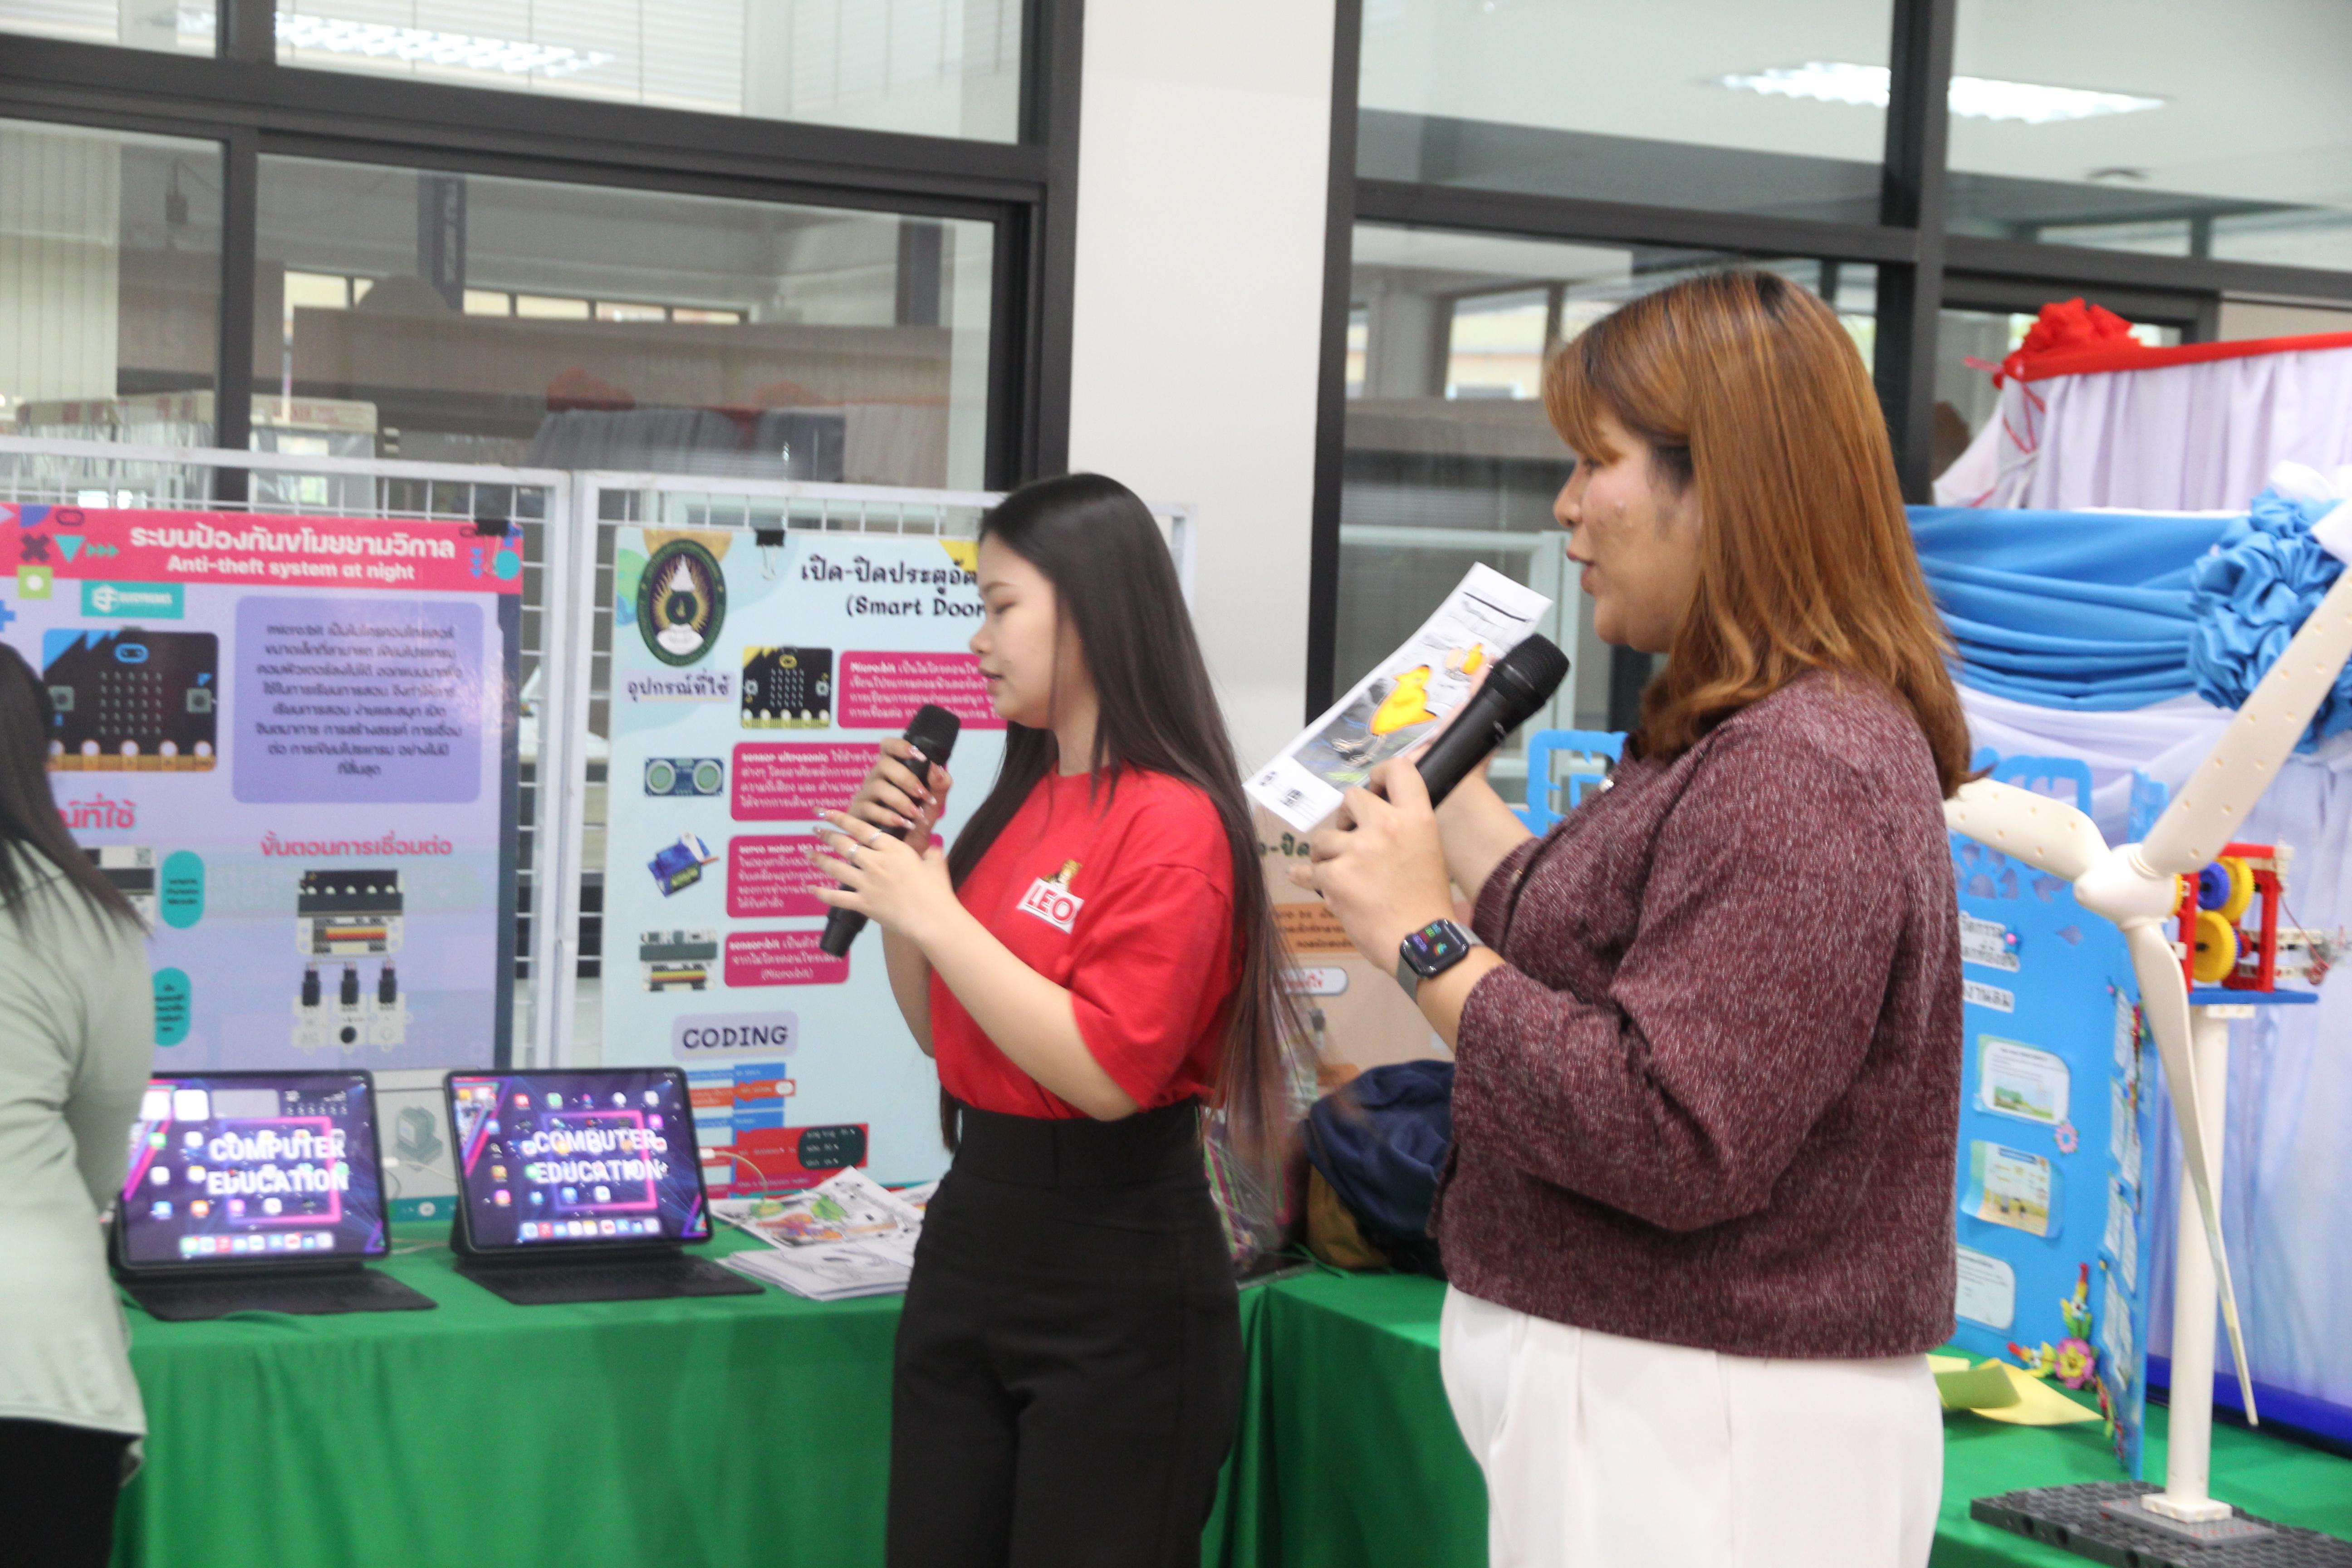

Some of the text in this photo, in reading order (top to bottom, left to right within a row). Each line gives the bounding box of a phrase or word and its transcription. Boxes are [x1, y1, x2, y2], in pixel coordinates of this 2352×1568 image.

[130, 522, 455, 559] ระบบป้องกันขโมยยามวิกาล
[167, 554, 415, 583] Anti-theft system at night
[847, 594, 923, 617] (Smart
[261, 831, 452, 856] ขั้นตอนการเชื่อมต่อ
[1026, 886, 1075, 921] LEO
[683, 1025, 789, 1049] CODING
[208, 1137, 346, 1160] COMPUTER
[532, 1128, 657, 1153] COMPUTER
[206, 1169, 349, 1195] EDUCATION
[531, 1159, 663, 1183] EDUCATION
